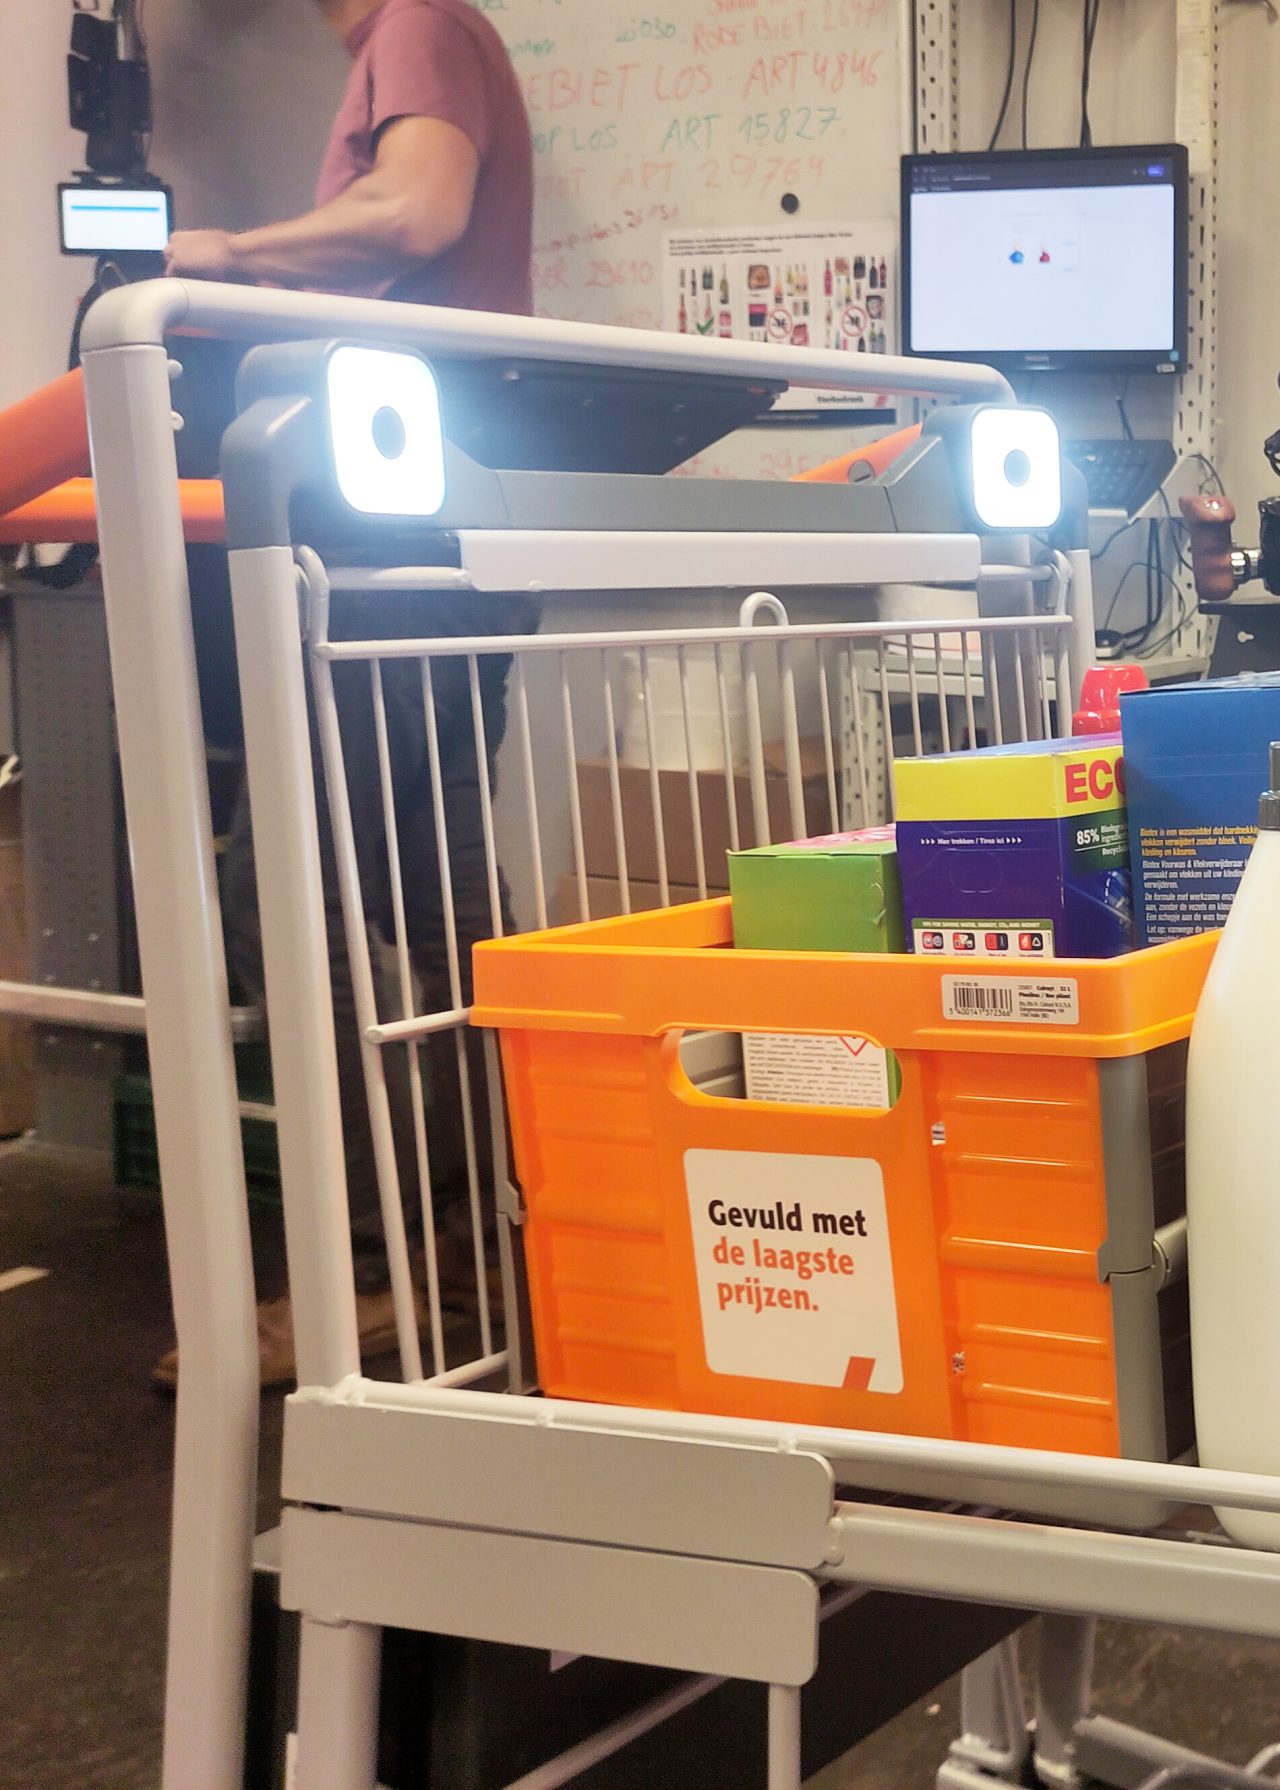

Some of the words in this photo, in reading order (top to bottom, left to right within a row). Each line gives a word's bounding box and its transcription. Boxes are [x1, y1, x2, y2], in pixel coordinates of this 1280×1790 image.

[742, 51, 807, 100] ART
[572, 125, 618, 151] LOS
[661, 113, 721, 153] ART
[739, 107, 842, 143] 15827
[1077, 828, 1100, 845] 85%
[708, 1200, 802, 1232] Gevuld
[813, 1208, 868, 1237] met
[713, 1236, 745, 1265] de
[754, 1239, 855, 1280] laagste
[717, 1278, 819, 1314] prijzen.
